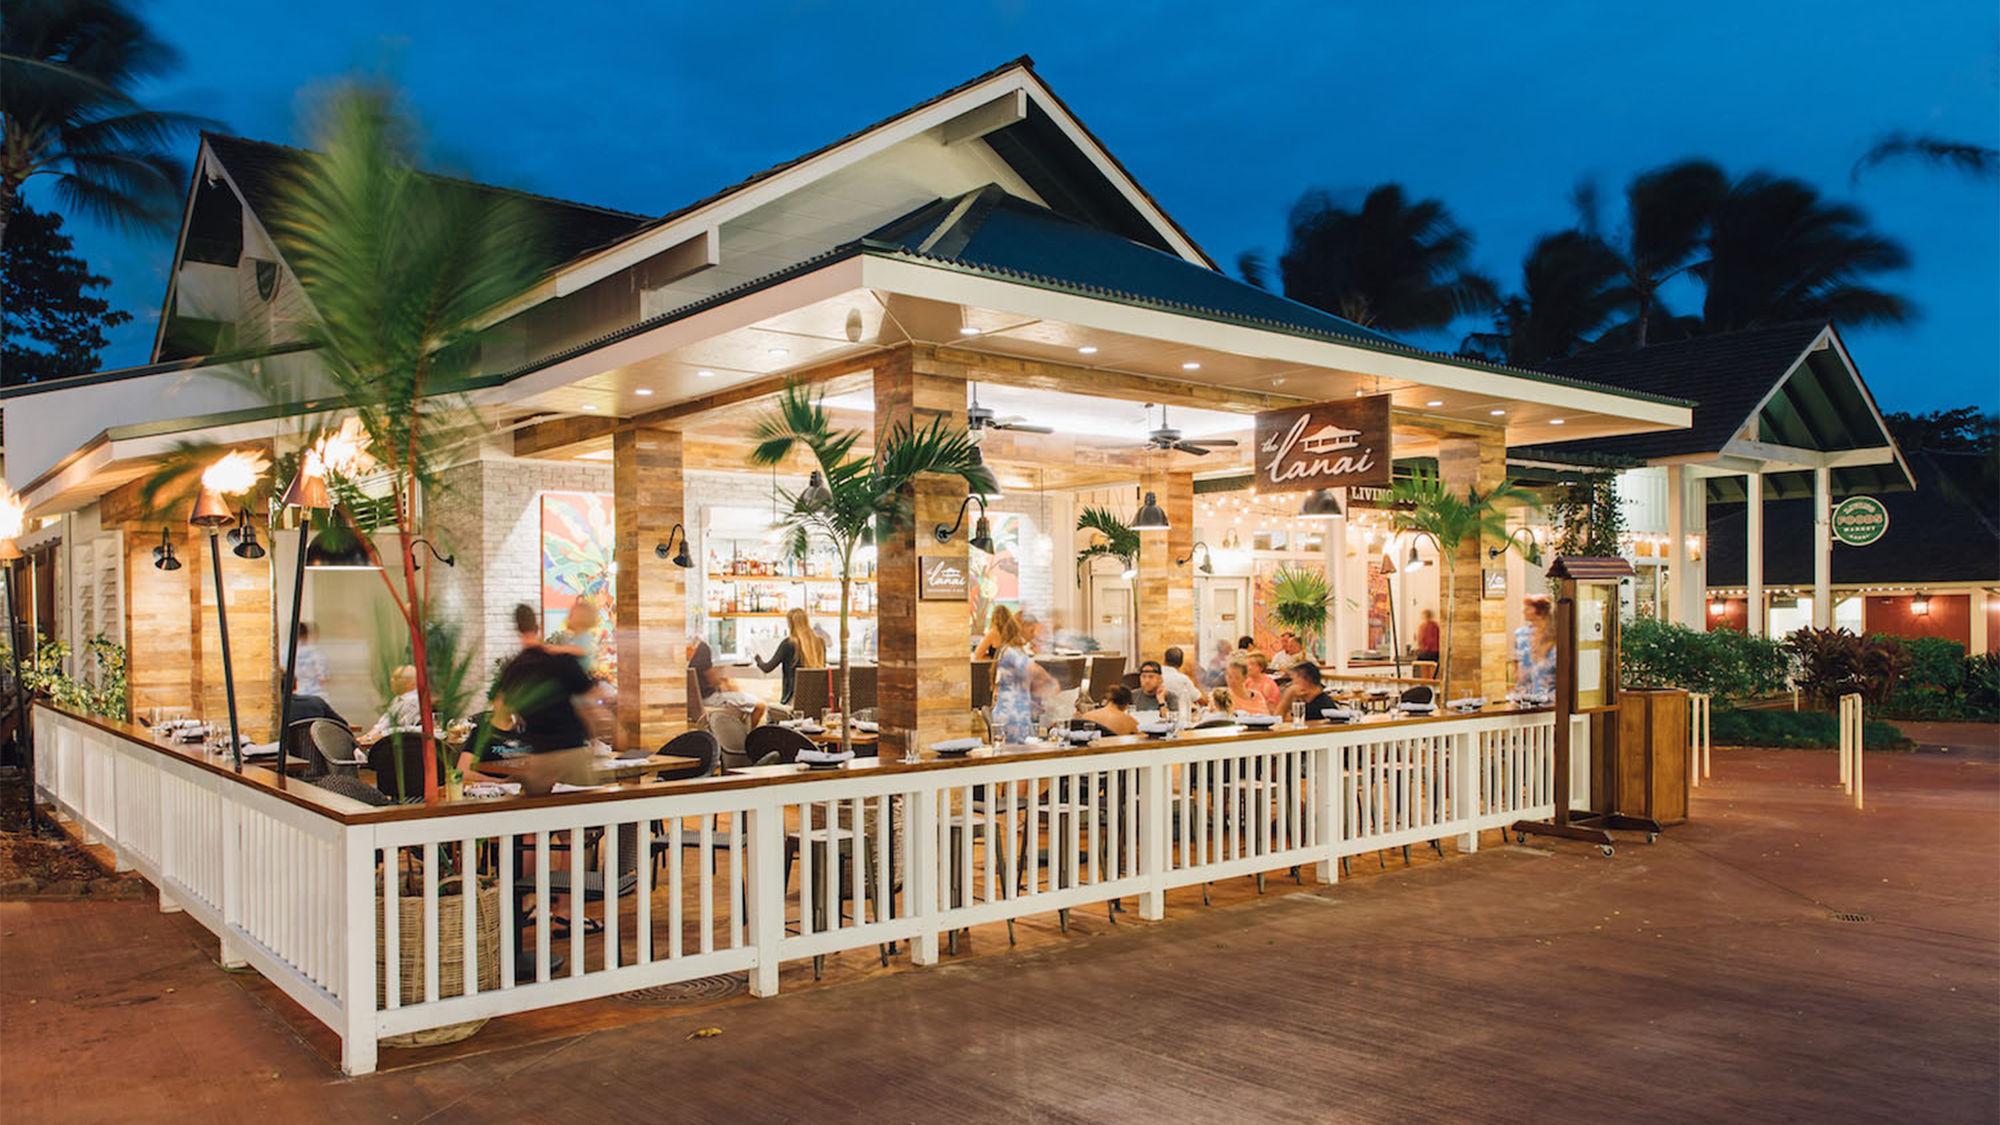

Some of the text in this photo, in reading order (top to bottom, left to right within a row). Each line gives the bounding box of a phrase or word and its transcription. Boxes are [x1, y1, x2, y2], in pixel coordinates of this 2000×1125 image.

[1260, 432, 1279, 453] the
[1265, 413, 1375, 484] lanai
[1351, 486, 1394, 502] LIVING
[1837, 513, 1883, 525] FOODS
[928, 561, 966, 586] lanai
